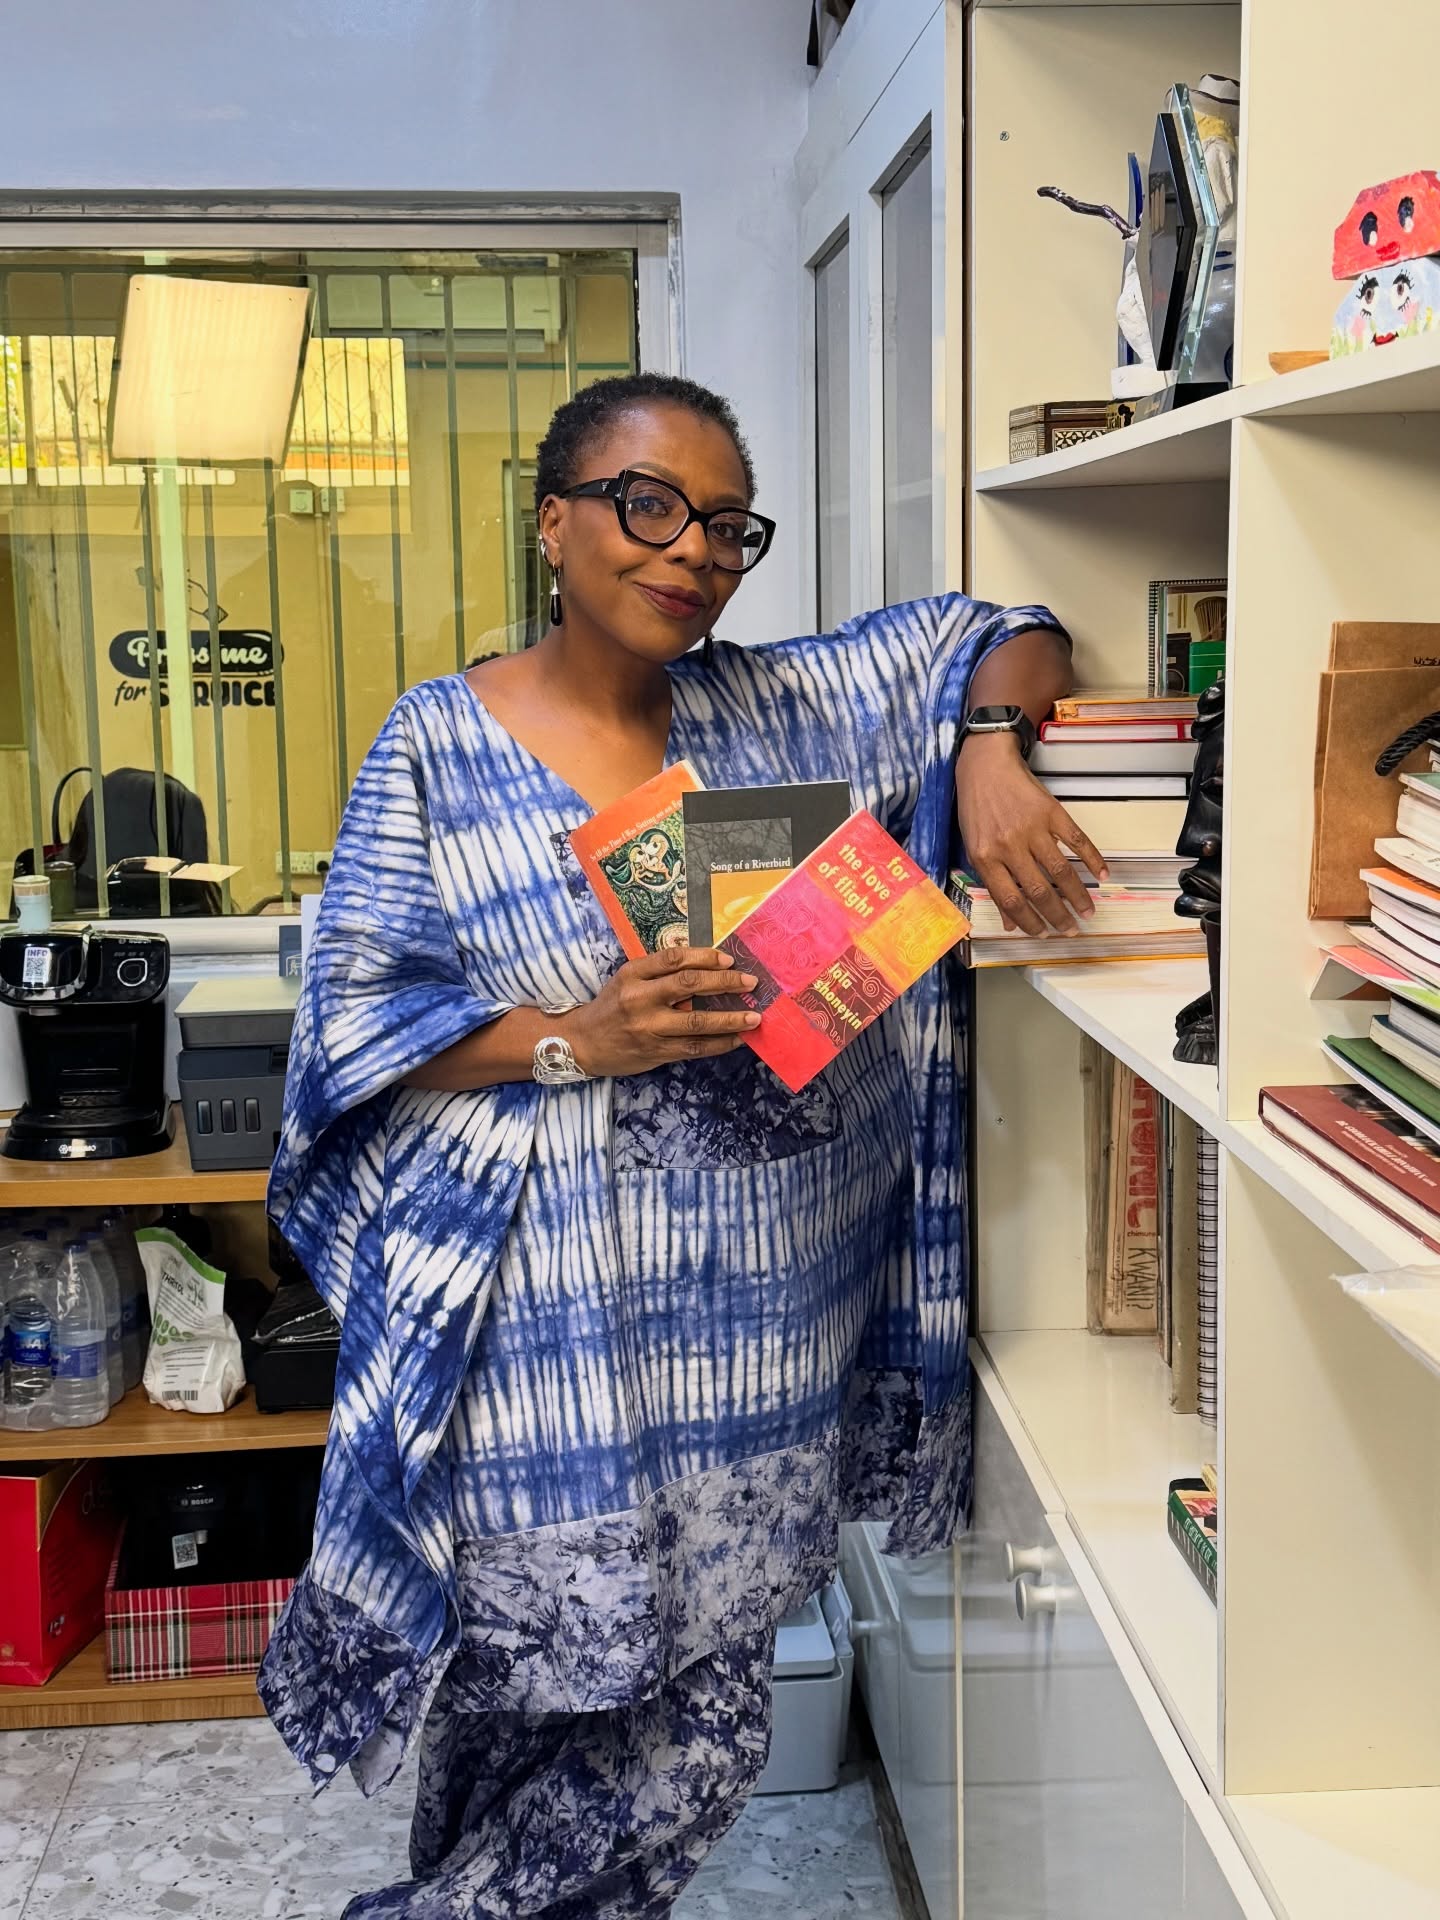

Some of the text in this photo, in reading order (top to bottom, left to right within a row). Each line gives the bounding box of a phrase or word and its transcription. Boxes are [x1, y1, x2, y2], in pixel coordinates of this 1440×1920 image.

[114, 681, 147, 707] for
[710, 861, 733, 873] Song
[734, 859, 744, 870] of
[751, 856, 792, 869] Riverbird
[837, 843, 891, 901] the love
[885, 855, 911, 882] for
[817, 861, 875, 919] of flight
[27, 949, 48, 958] INFO
[812, 979, 863, 1031] shoneyin
[1126, 1247, 1158, 1310] KWANI?
